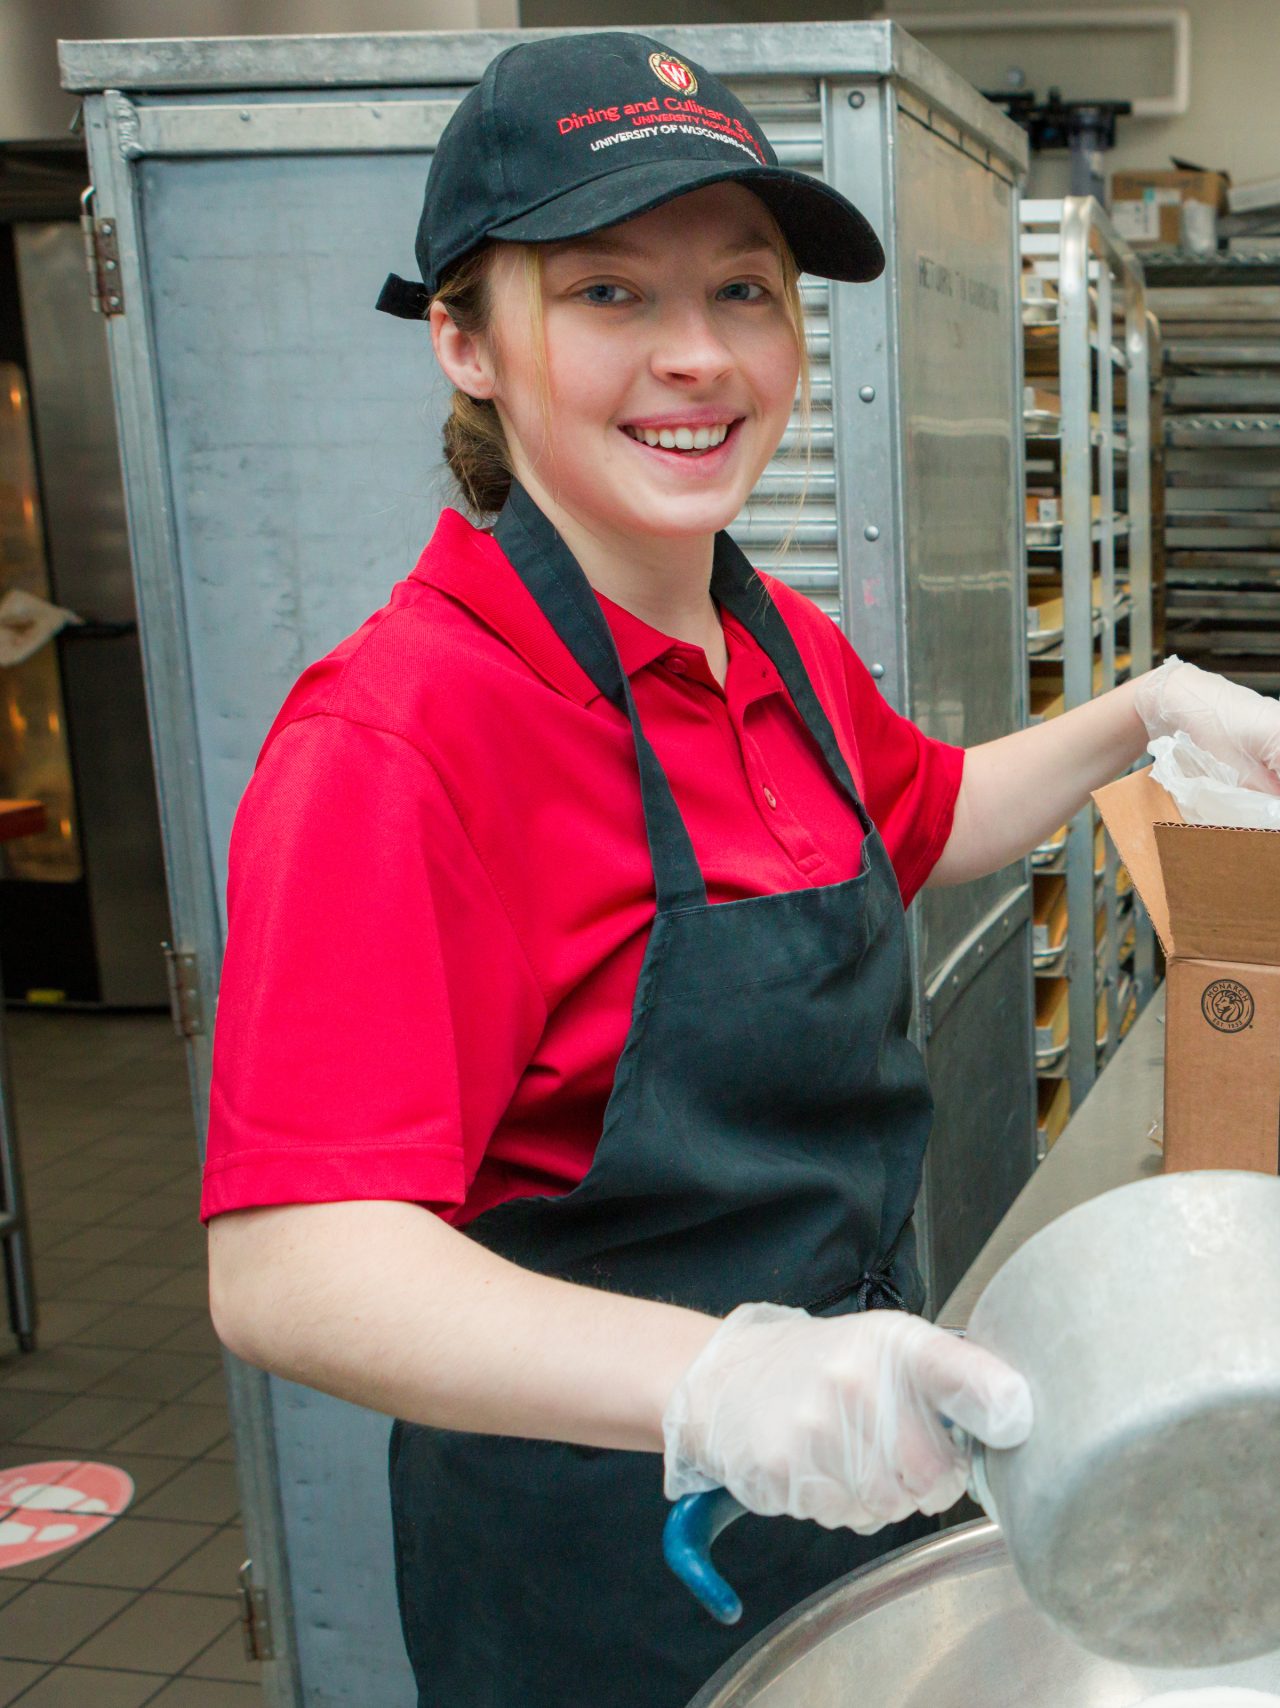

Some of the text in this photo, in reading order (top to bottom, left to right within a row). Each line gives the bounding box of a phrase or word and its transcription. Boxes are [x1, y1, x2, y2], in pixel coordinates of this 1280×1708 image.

[660, 63, 688, 87] W
[557, 97, 731, 135] Dining and Culinary
[632, 113, 700, 126] UNIVERSITY
[590, 126, 658, 151] UNIVERSITY
[660, 124, 678, 134] OF
[1207, 983, 1249, 1001] MONARCH
